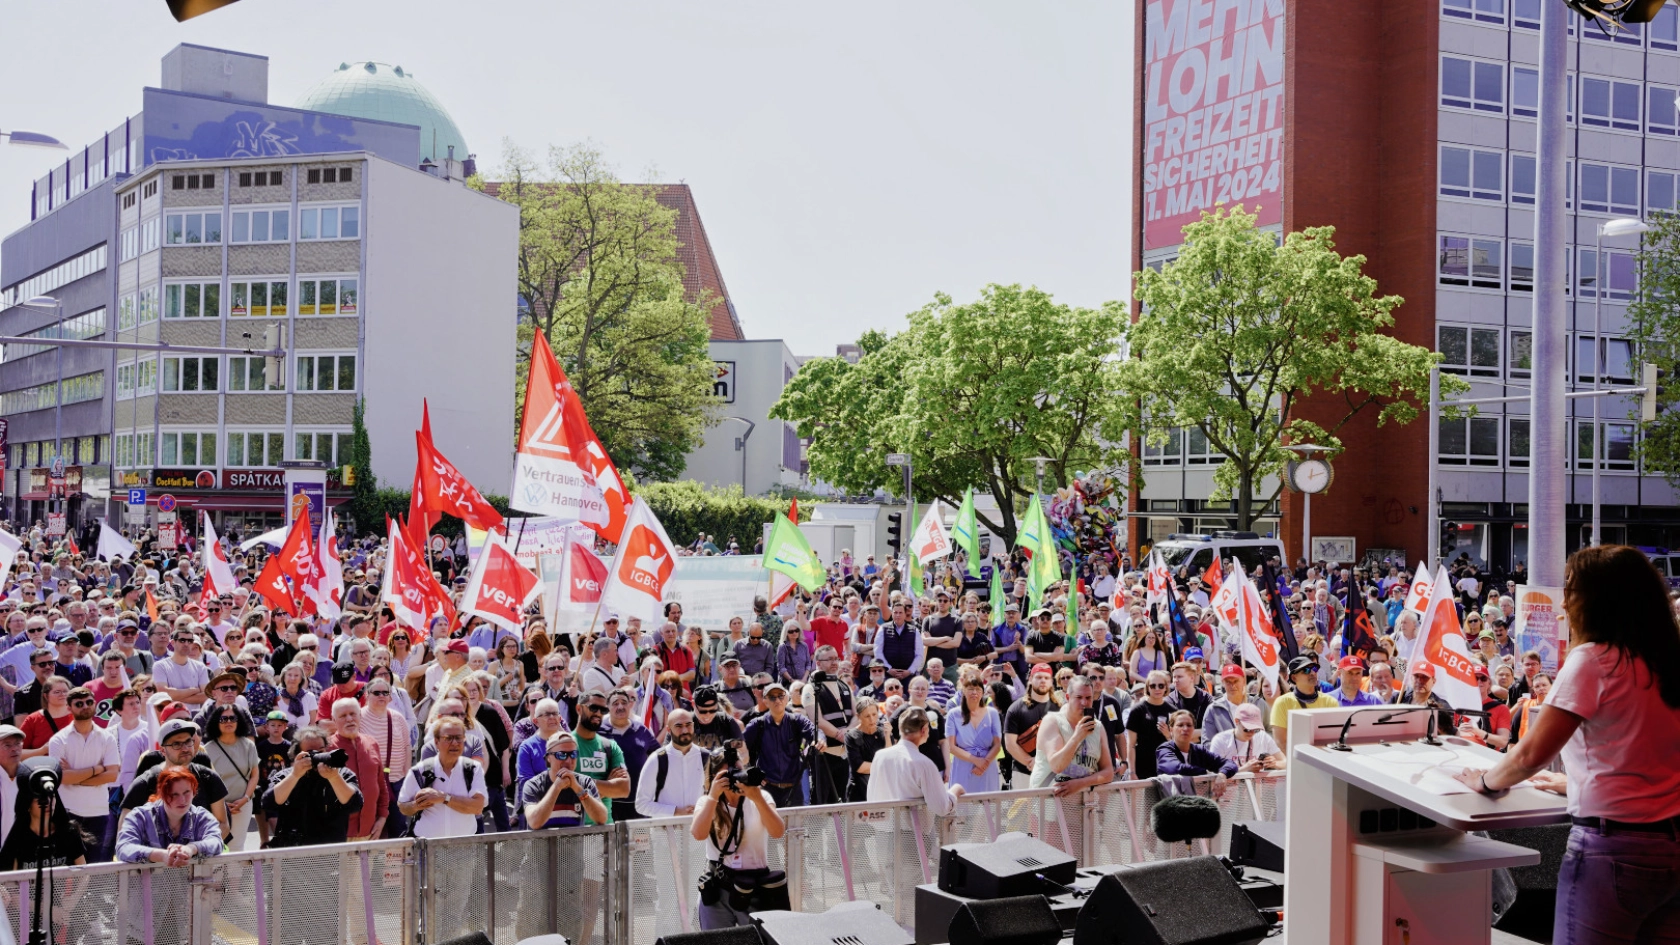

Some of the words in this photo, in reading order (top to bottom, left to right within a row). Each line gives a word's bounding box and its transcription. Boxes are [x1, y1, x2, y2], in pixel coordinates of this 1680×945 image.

[1146, 18, 1283, 124] LOHN
[1147, 84, 1282, 163] FREIZEIT
[1146, 128, 1282, 192] SICHERHEIT
[1147, 191, 1161, 222] 1.
[1165, 177, 1213, 218] MAI
[1217, 163, 1280, 204] 2024
[155, 476, 181, 487] Cocktail
[182, 476, 195, 487] Bar
[523, 465, 590, 488] Vertrauens
[131, 491, 140, 503] P
[551, 491, 603, 512] Hannover
[930, 529, 945, 551] NGG
[630, 570, 659, 593] IGBCE
[1438, 646, 1473, 677] IGBCE
[582, 758, 603, 769] D&G
[869, 811, 886, 819] ASC
